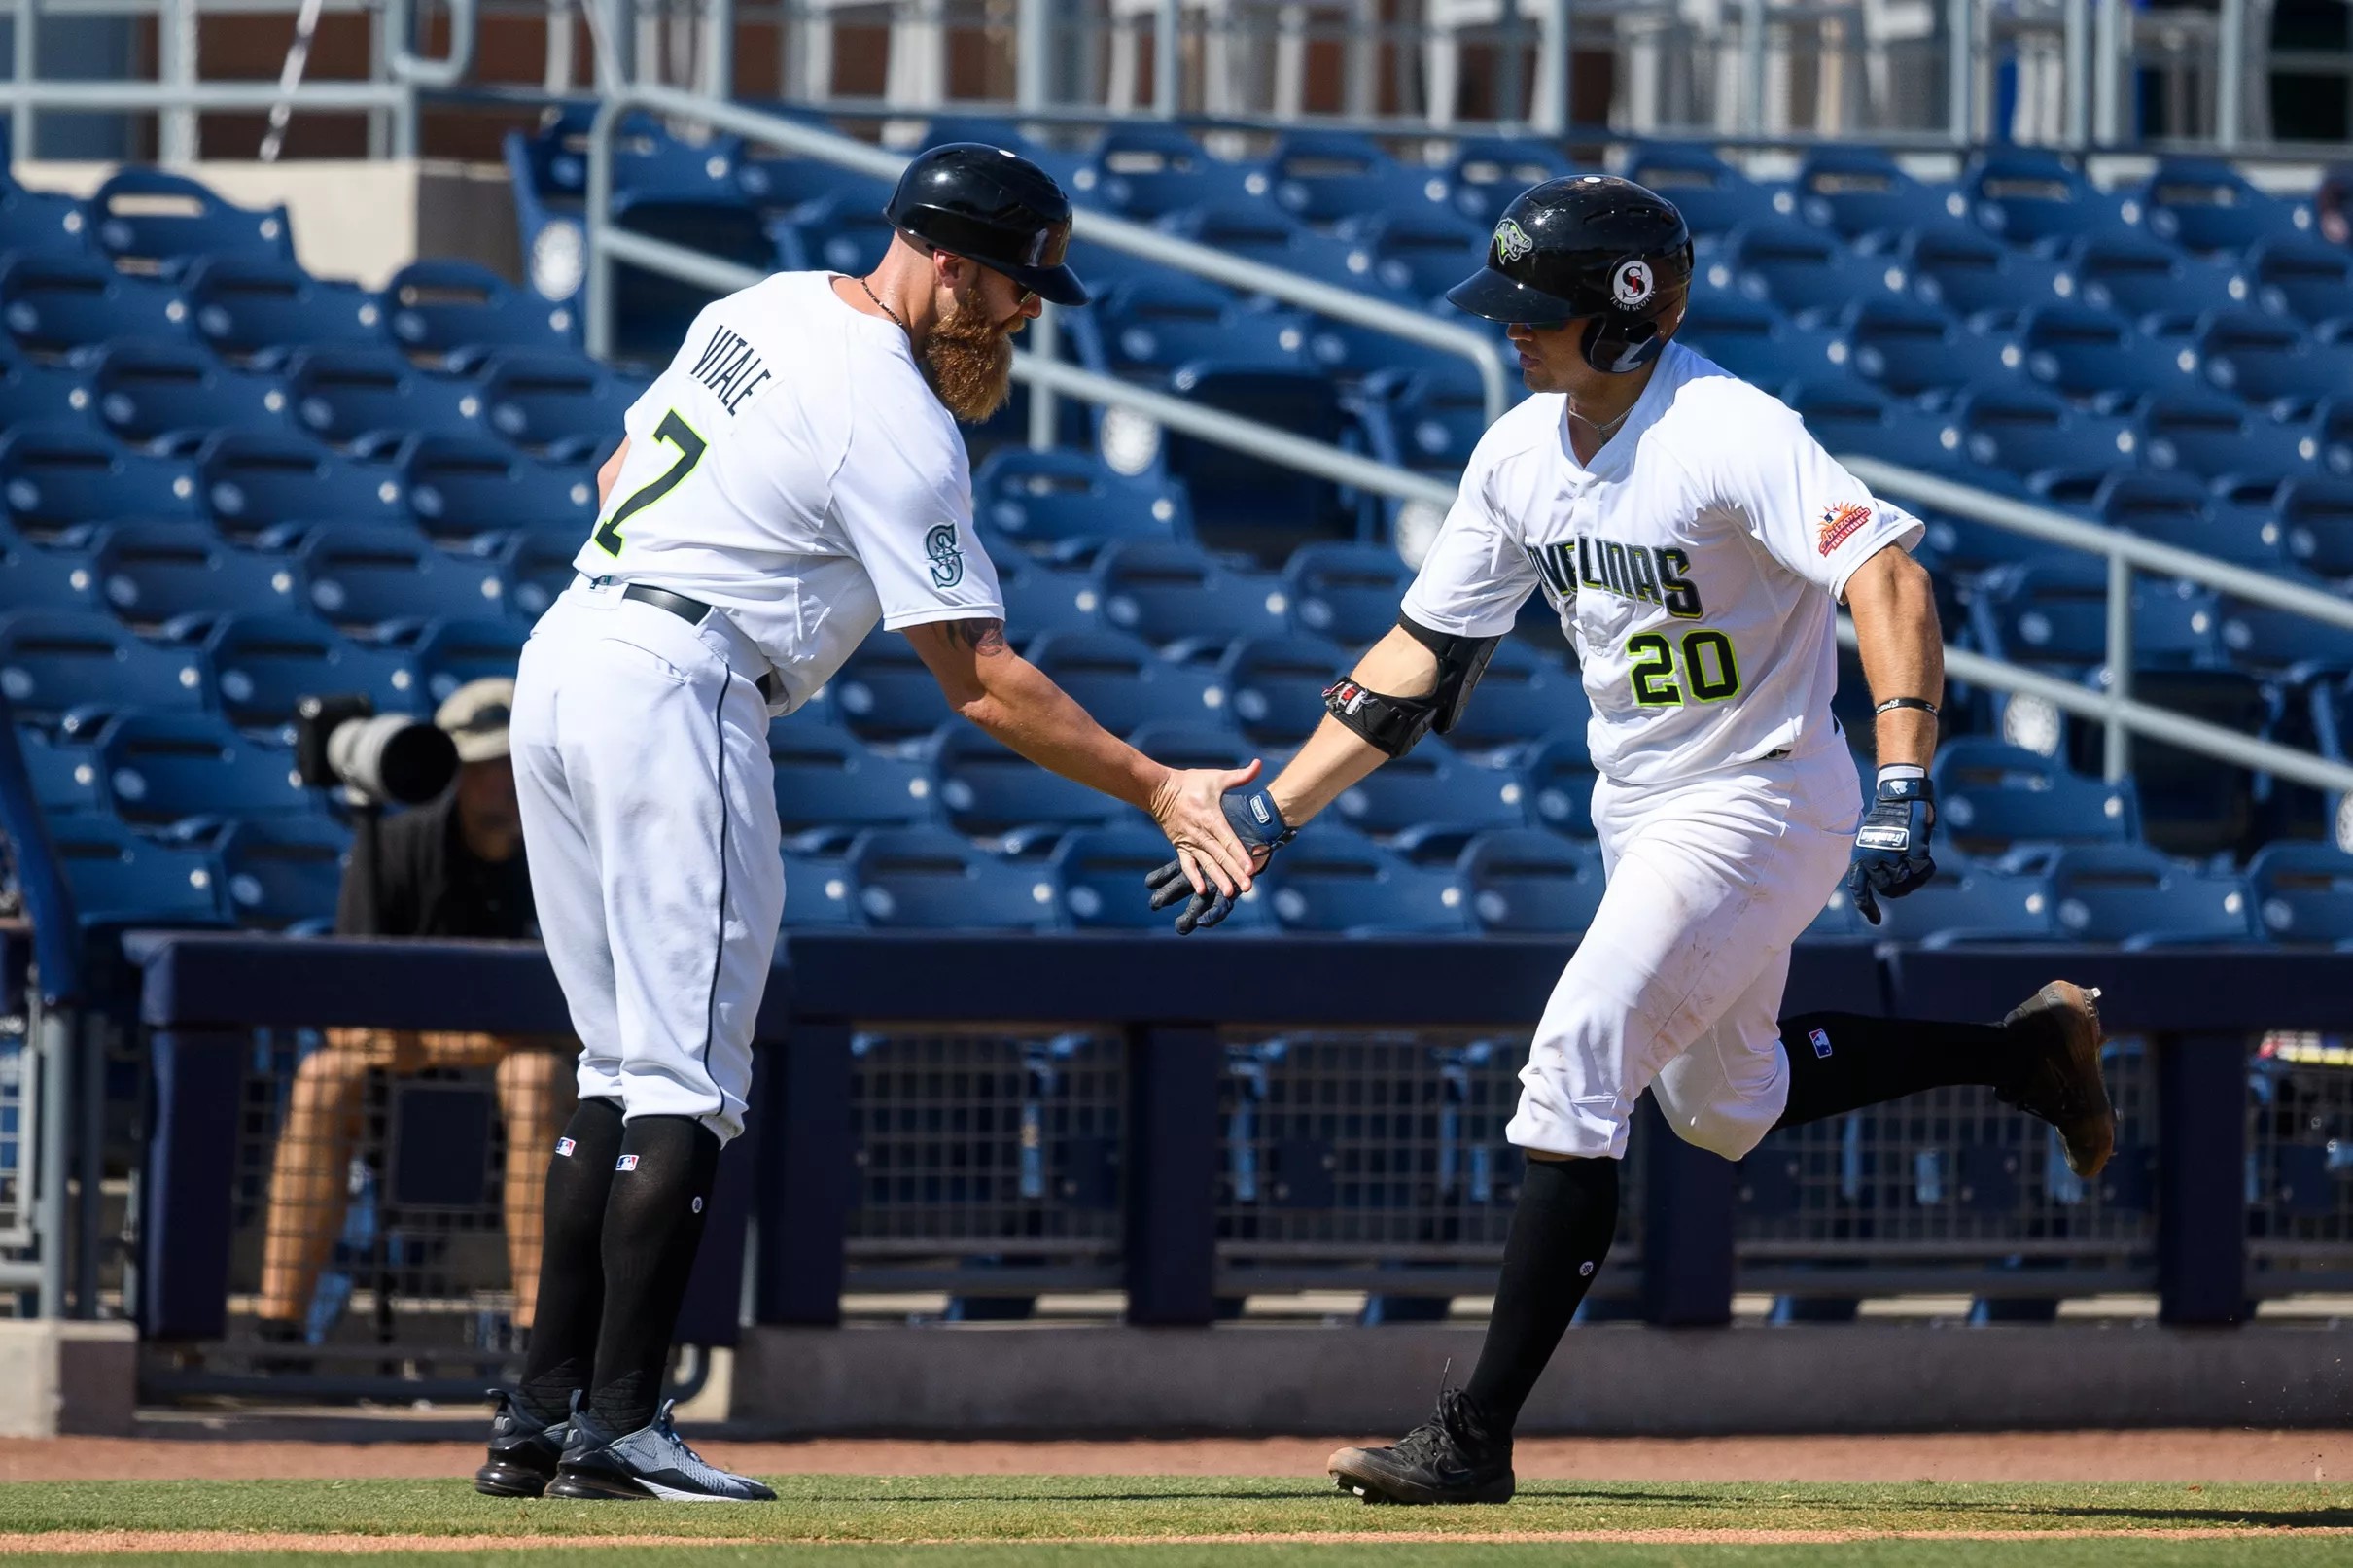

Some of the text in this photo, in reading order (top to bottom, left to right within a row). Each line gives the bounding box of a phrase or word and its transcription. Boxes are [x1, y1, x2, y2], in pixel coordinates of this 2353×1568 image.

[1609, 296, 1631, 312] TEAM
[689, 324, 772, 418] VITALE
[594, 407, 709, 559] 7
[1625, 628, 1742, 707] 20
